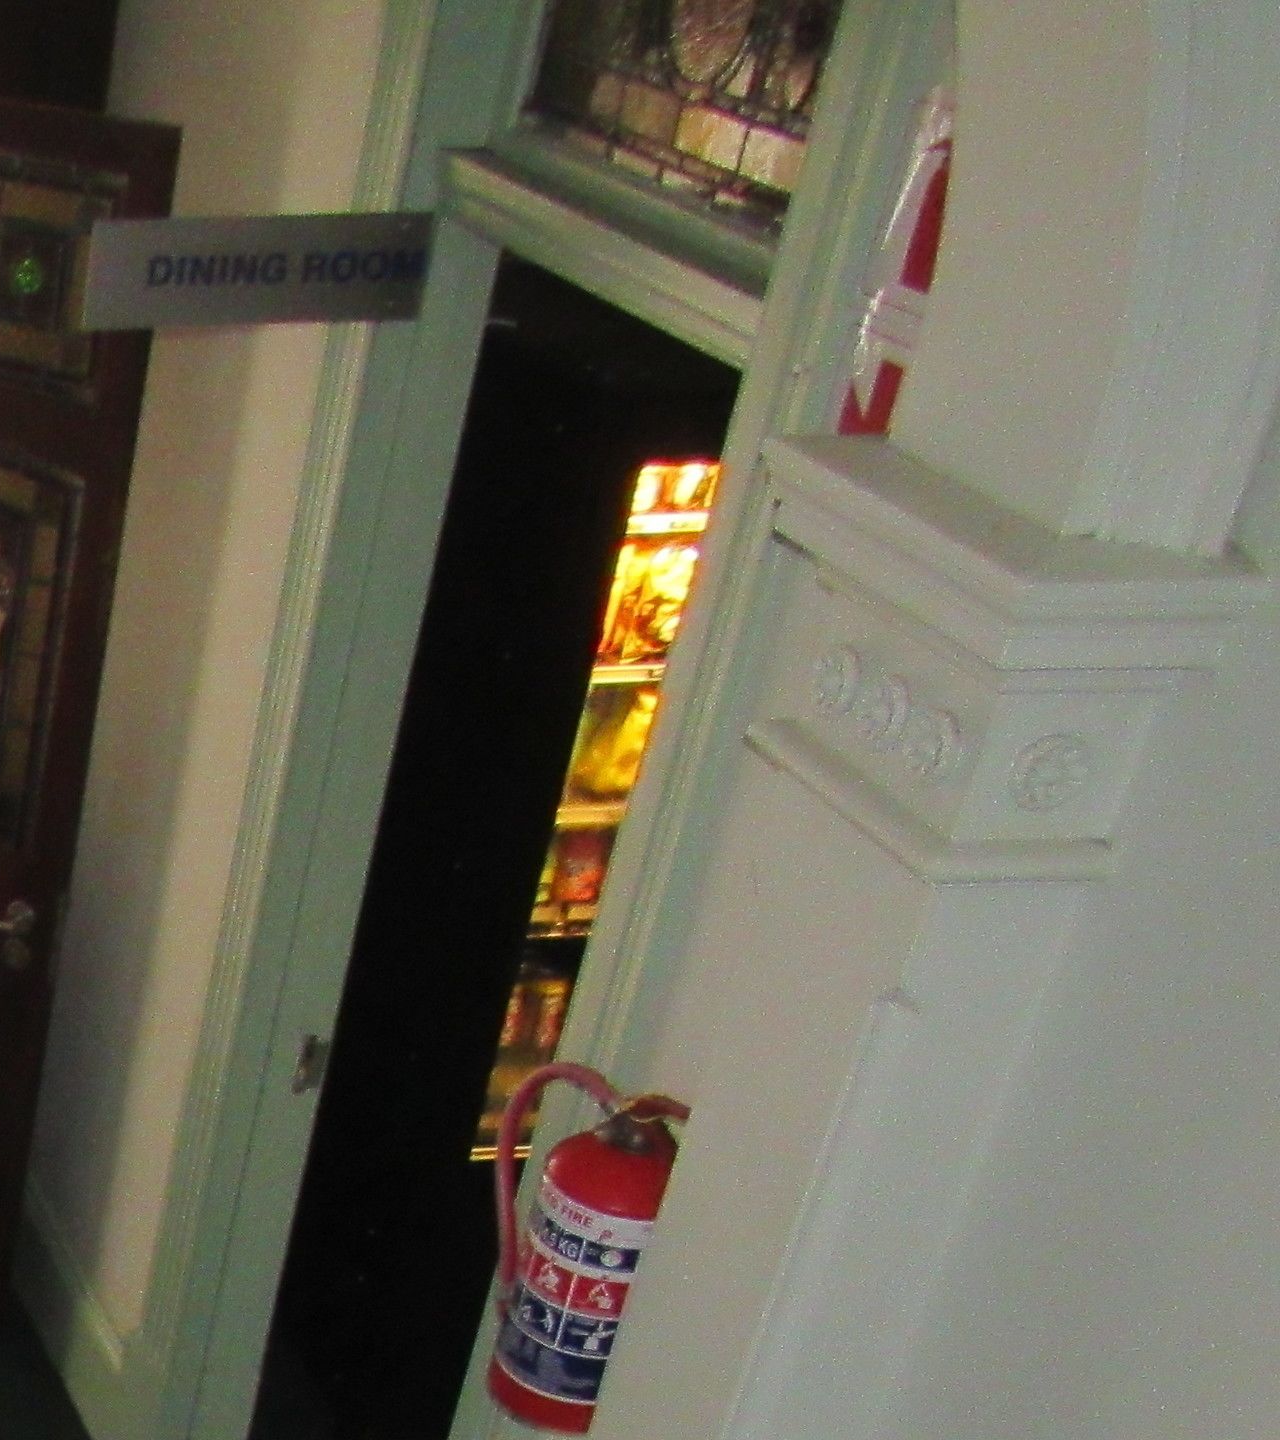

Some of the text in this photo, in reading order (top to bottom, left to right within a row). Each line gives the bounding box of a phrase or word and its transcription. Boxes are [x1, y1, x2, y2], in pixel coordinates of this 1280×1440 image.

[146, 248, 428, 287] DINING ROOM
[560, 1204, 594, 1229] FIRE
